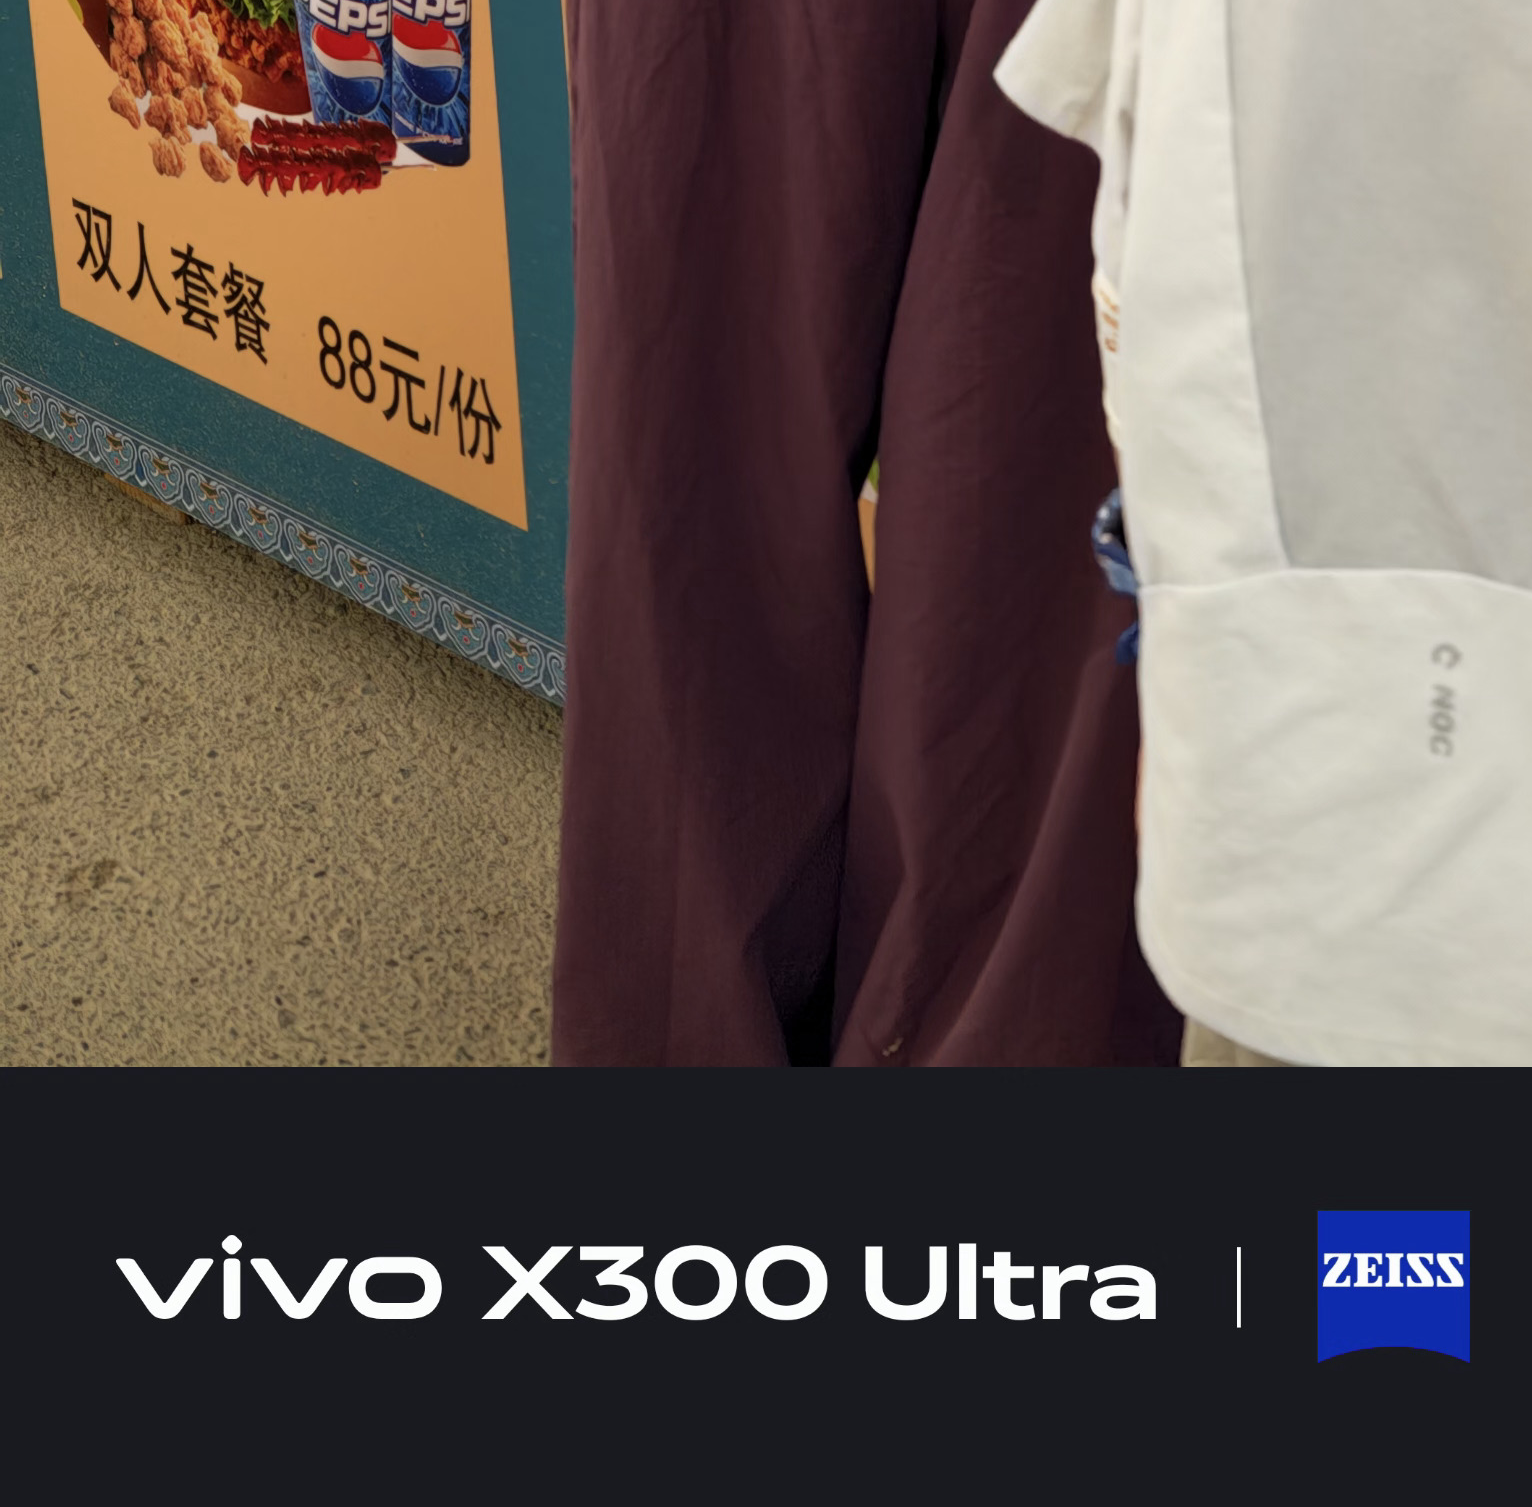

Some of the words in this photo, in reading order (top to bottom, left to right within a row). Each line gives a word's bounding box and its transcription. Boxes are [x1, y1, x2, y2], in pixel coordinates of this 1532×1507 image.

[71, 197, 271, 365] 双人套餐
[318, 315, 502, 464] 88元/份
